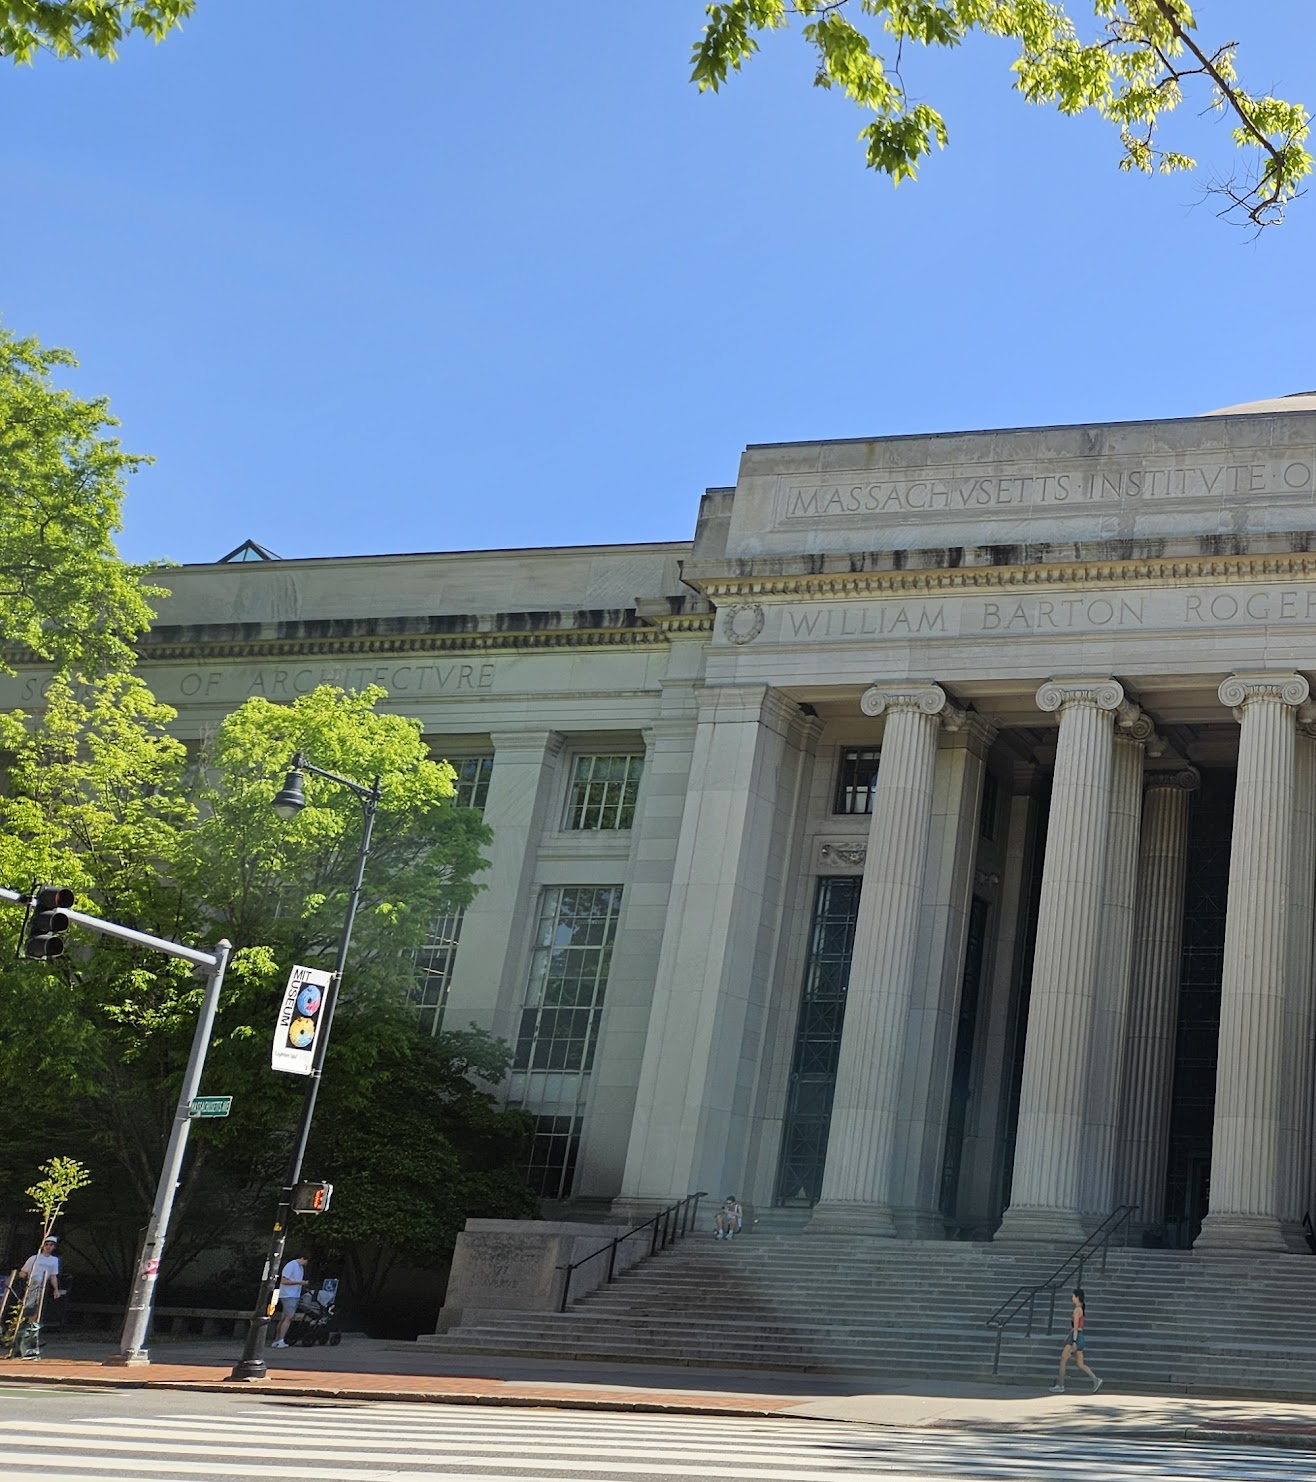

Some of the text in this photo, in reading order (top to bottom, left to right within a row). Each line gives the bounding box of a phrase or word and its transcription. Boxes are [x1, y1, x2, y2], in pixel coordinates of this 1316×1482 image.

[790, 474, 1071, 514] MASSACHVSETTS
[1088, 464, 1266, 499] INSTITVTE
[788, 604, 949, 637] WILLIAM
[981, 597, 1147, 630] BARTON
[180, 672, 222, 697] OF
[293, 968, 313, 982] MIT
